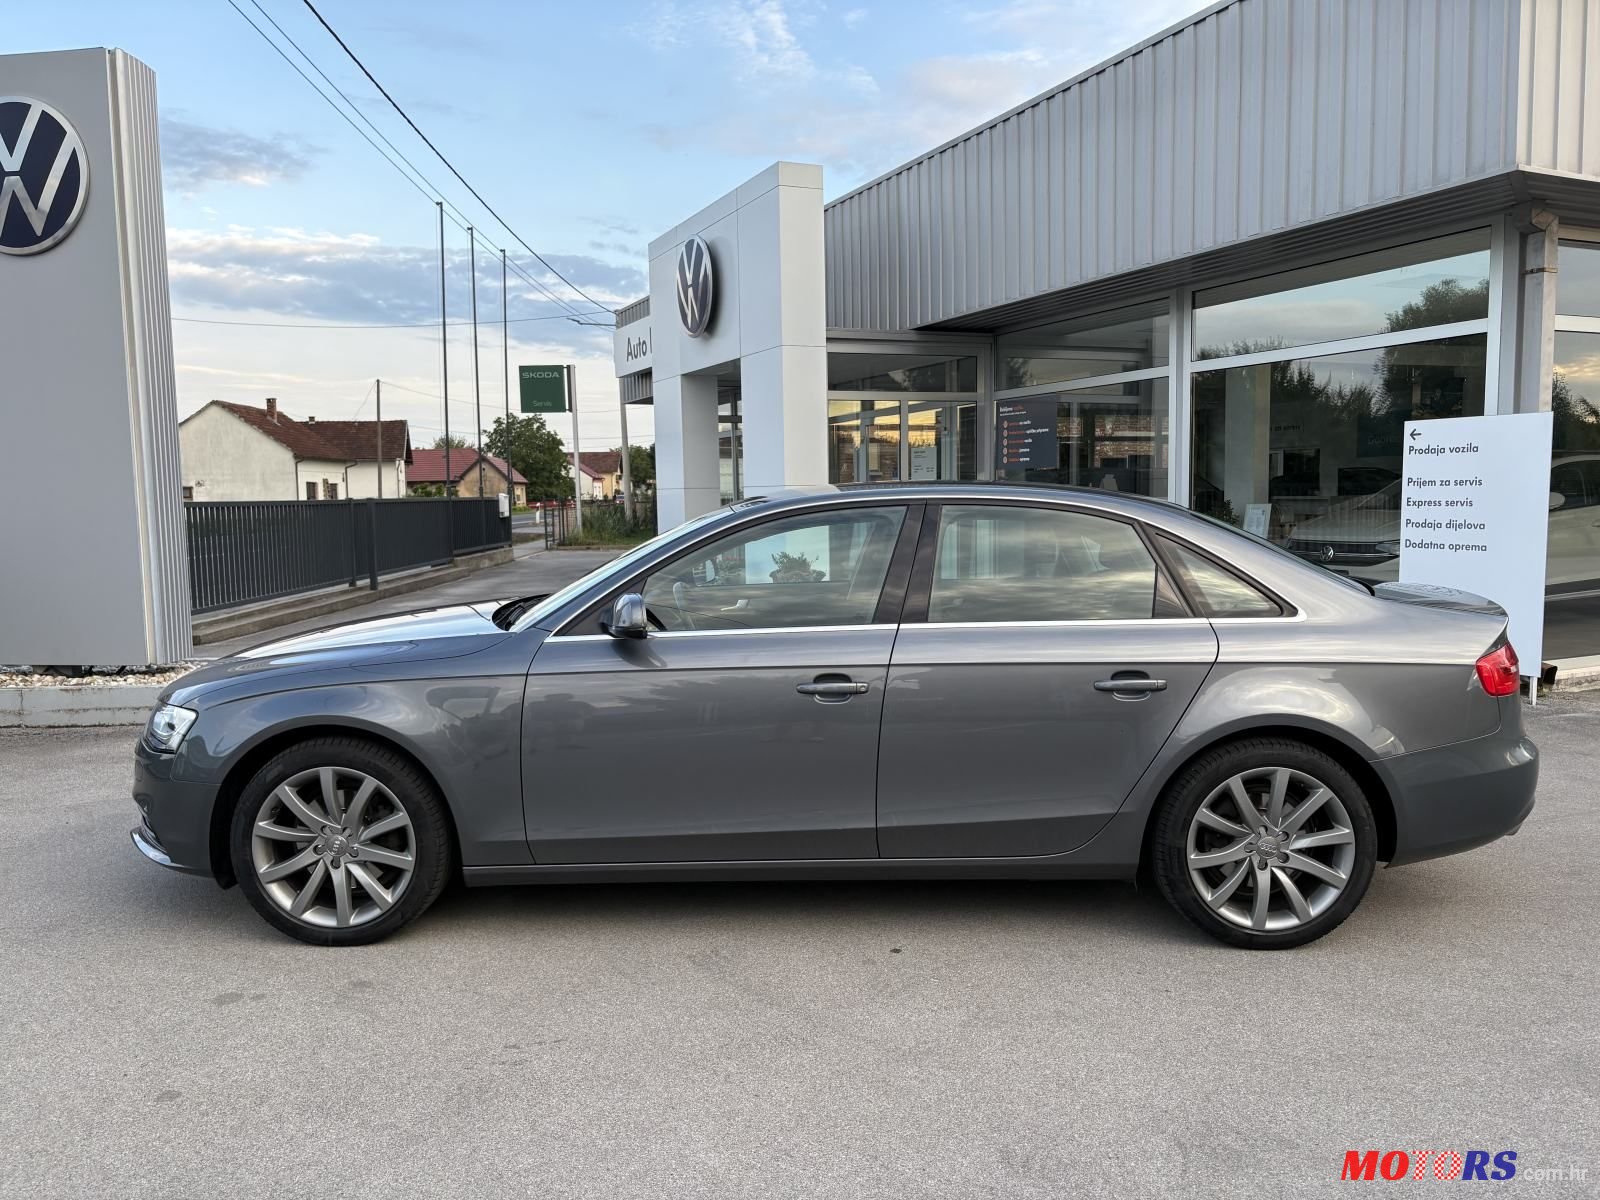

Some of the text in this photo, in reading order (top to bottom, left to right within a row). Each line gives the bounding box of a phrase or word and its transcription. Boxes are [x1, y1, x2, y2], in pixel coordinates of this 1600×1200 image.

[626, 336, 647, 362] Auto
[1408, 442, 1479, 456] Prodaja vozila
[1407, 476, 1483, 489] Prijem za servis
[1406, 497, 1473, 509] Express servis
[1405, 518, 1486, 531] Prodaja dijelova
[1404, 538, 1487, 552] Dodatna oprema
